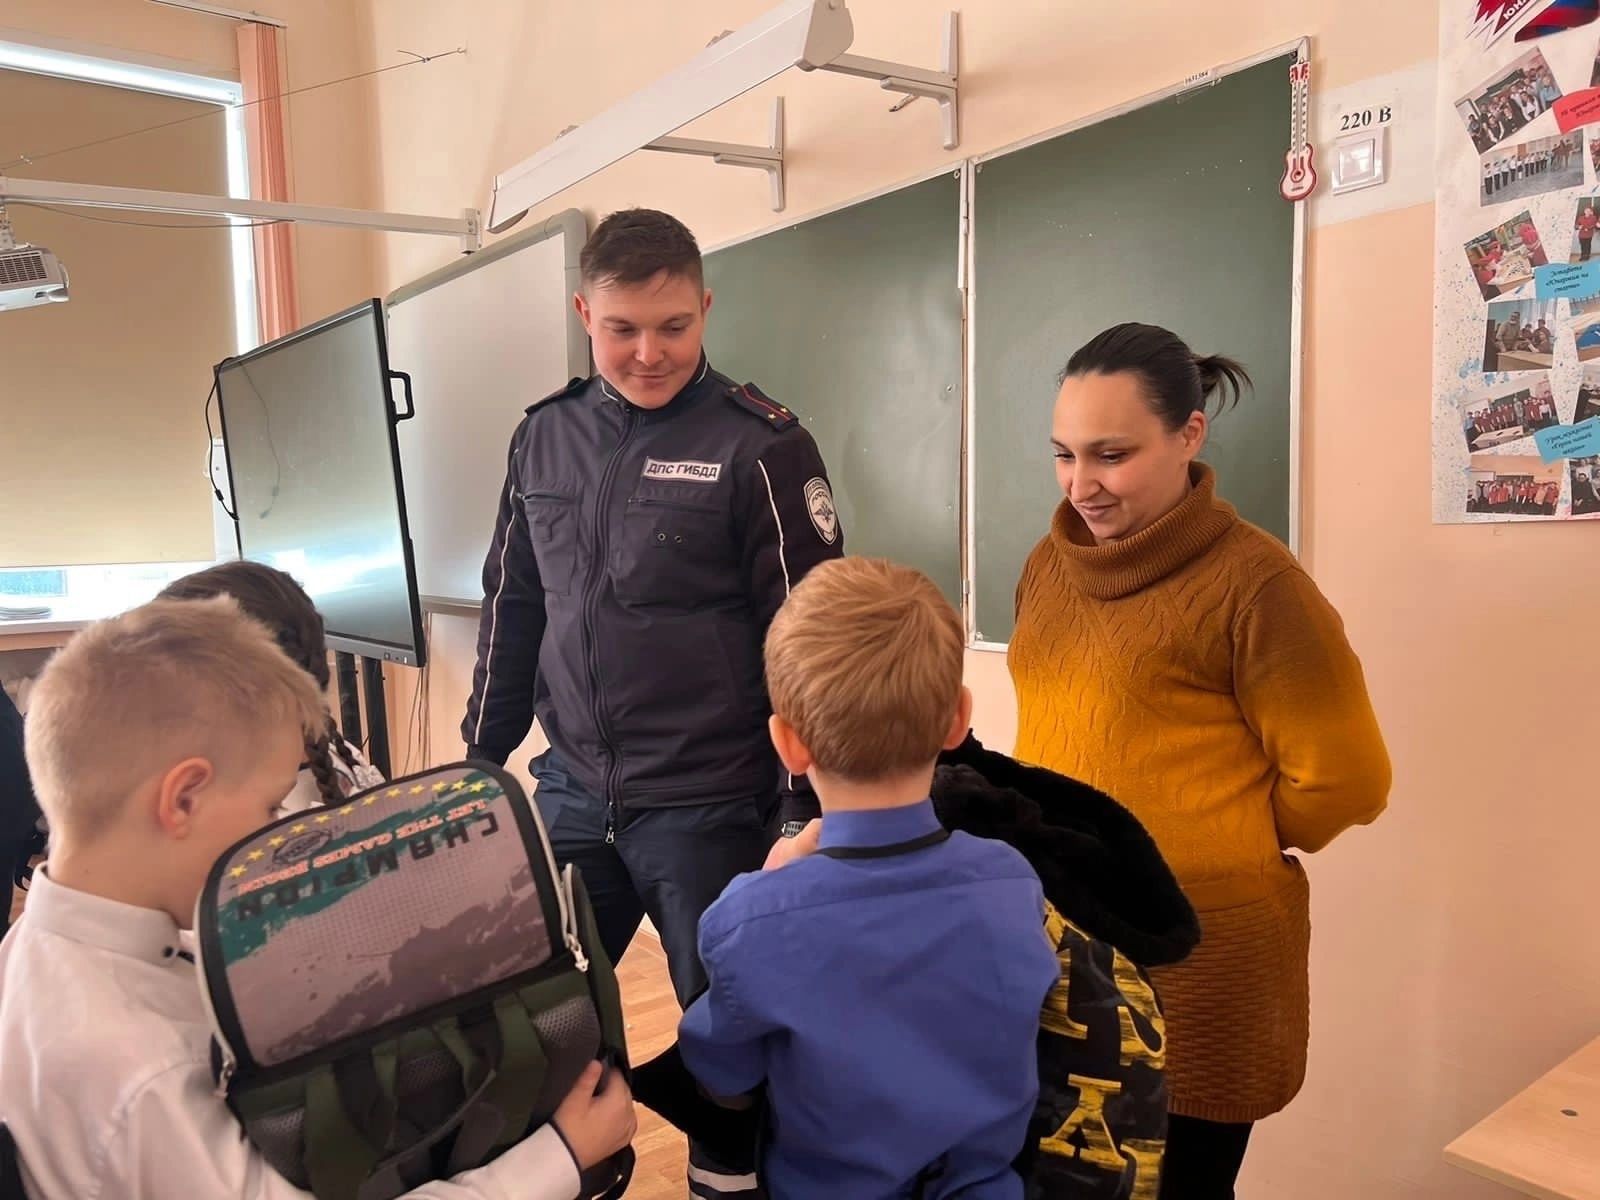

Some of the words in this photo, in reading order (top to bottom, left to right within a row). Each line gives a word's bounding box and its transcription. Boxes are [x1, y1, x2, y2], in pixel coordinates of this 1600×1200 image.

[1503, 0, 1526, 19] ЮН
[1340, 110, 1372, 131] 220
[1378, 105, 1392, 123] В
[646, 463, 675, 476] ДПС
[676, 464, 718, 478] ГИБДД
[445, 799, 487, 821] LET
[395, 815, 443, 839] THE
[312, 832, 393, 868] GAMES
[237, 811, 499, 921] CHAMPION
